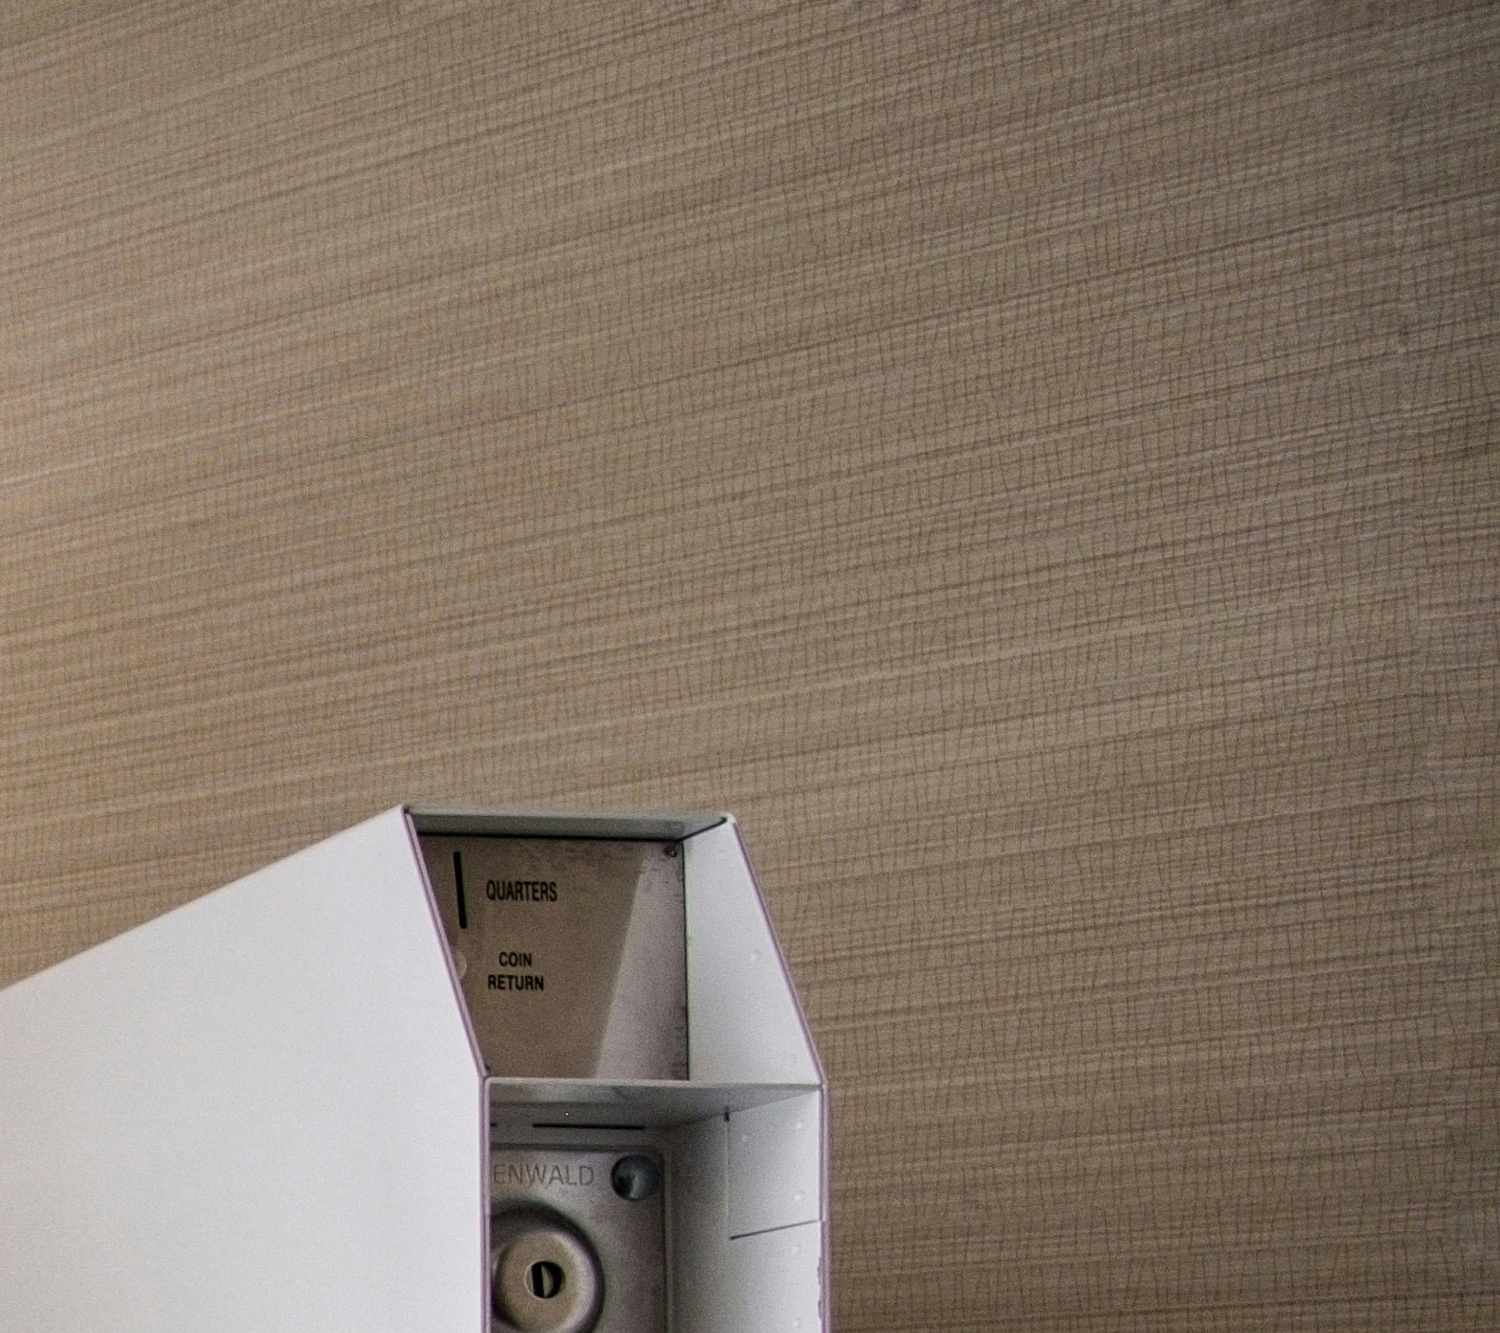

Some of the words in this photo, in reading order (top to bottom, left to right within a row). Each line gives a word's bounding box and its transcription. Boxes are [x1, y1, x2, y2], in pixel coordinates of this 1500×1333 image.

[486, 879, 558, 902] QUARTERS
[499, 952, 533, 967] COIN
[488, 974, 545, 991] RETURN
[493, 1164, 596, 1186] ENWALD
